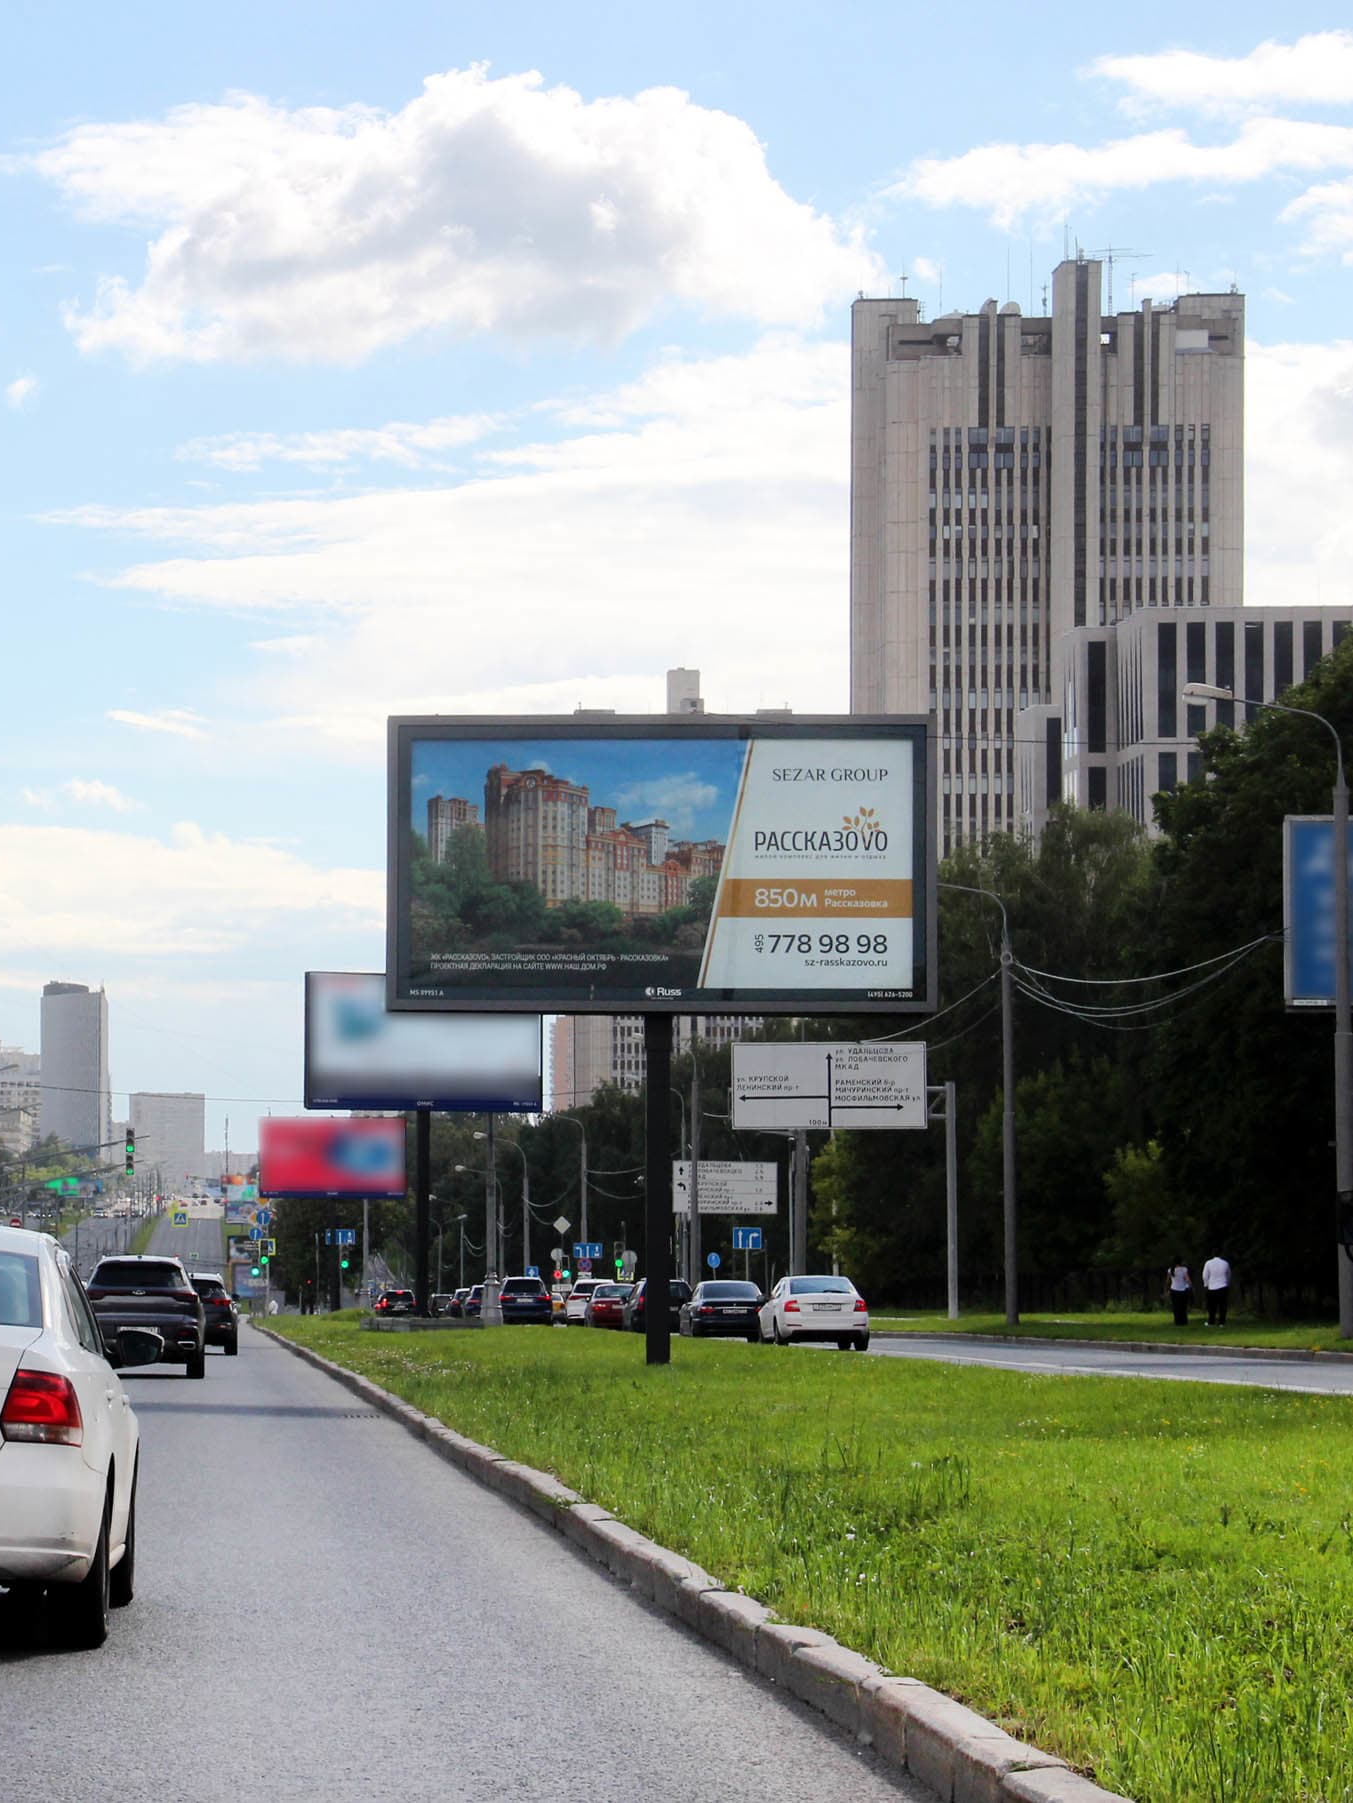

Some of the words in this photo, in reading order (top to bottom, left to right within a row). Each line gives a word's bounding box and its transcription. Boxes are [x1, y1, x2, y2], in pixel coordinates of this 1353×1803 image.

[772, 768, 826, 782] SEZAR
[830, 768, 888, 782] GROUP
[754, 888, 817, 908] 850м
[824, 889, 856, 898] метро
[824, 898, 888, 908] Рассказовка
[754, 934, 764, 953] 495
[767, 934, 812, 954] 778
[819, 934, 850, 954] 98
[856, 934, 888, 954] 98
[804, 957, 888, 967] sz-rasskazovo.ru
[656, 987, 682, 996] Russ
[748, 1074, 789, 1082] КРУПСКОЙ
[737, 1083, 782, 1091] ЛЕНИНСКИЙ
[835, 1094, 910, 1102] МОСФИЛЬМОВСКАЯ
